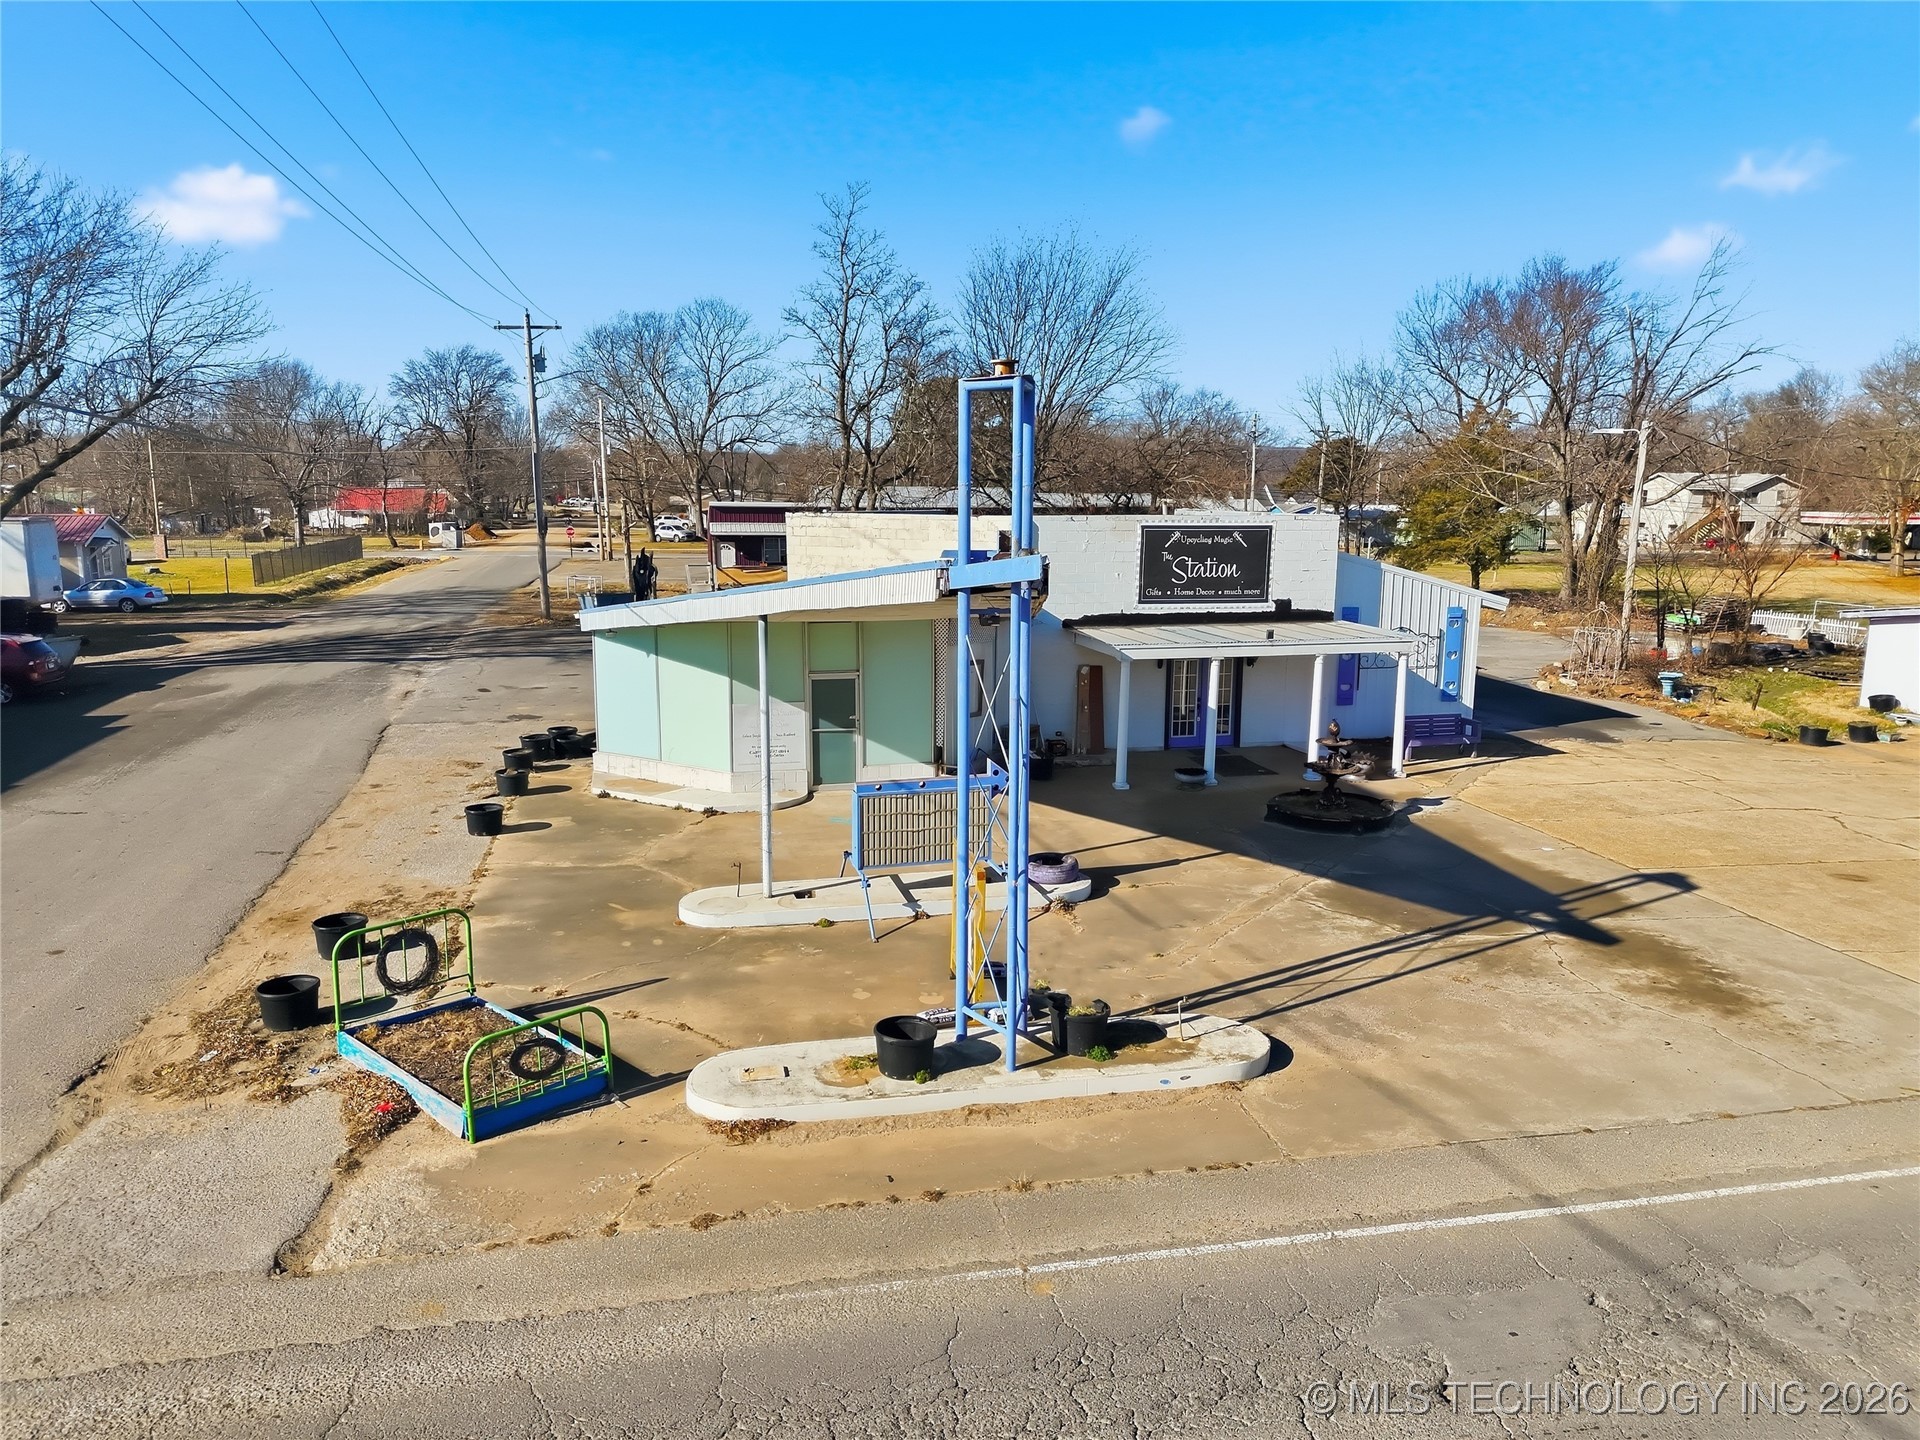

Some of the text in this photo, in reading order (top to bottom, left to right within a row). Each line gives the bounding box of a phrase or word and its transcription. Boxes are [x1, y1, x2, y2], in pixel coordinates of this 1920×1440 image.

[1181, 534, 1233, 544] Upcycling Magic
[1162, 552, 1174, 562] The
[1171, 556, 1241, 584] Station
[1174, 588, 1194, 596] Home
[1196, 588, 1215, 596] Decor
[1224, 586, 1242, 595] much
